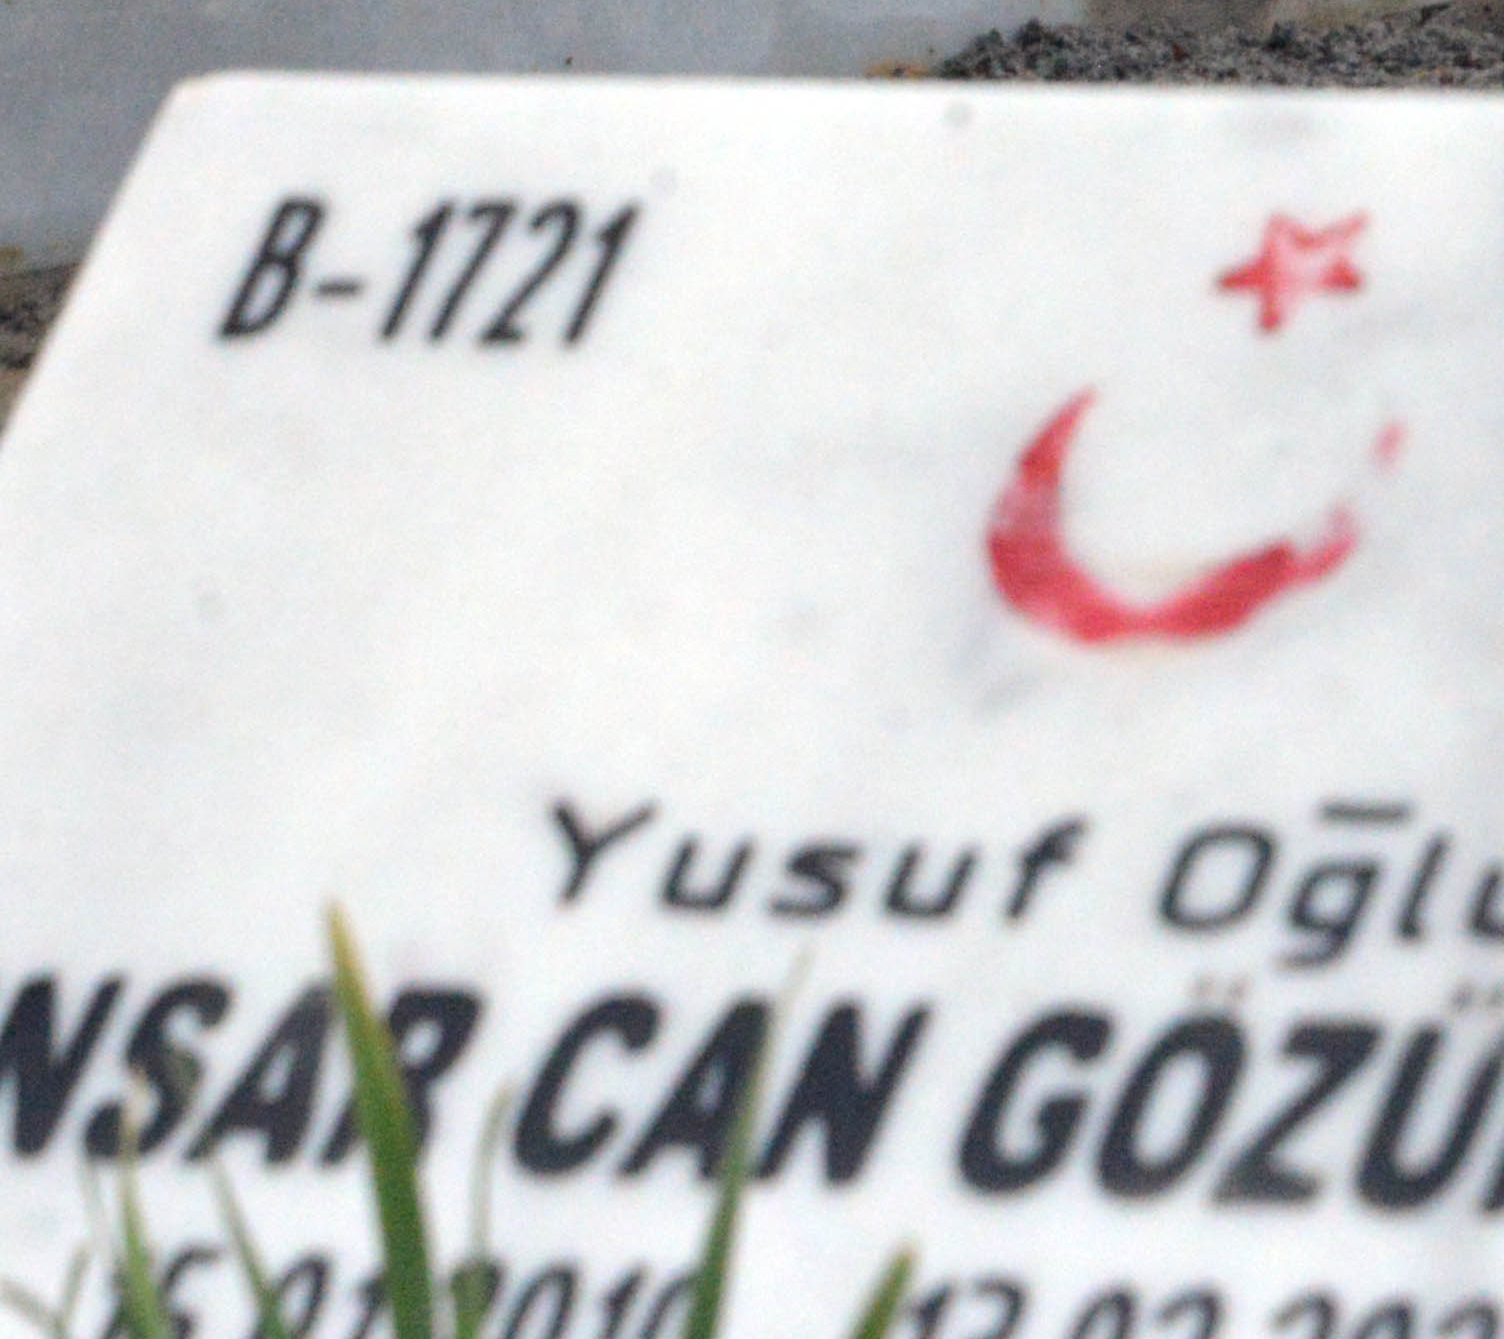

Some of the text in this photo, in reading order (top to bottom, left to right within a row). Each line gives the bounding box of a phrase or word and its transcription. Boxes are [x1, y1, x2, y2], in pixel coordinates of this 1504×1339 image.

[214, 193, 644, 346] B-1721
[548, 797, 1092, 927] Yusuf
[510, 985, 936, 1189] CAN
